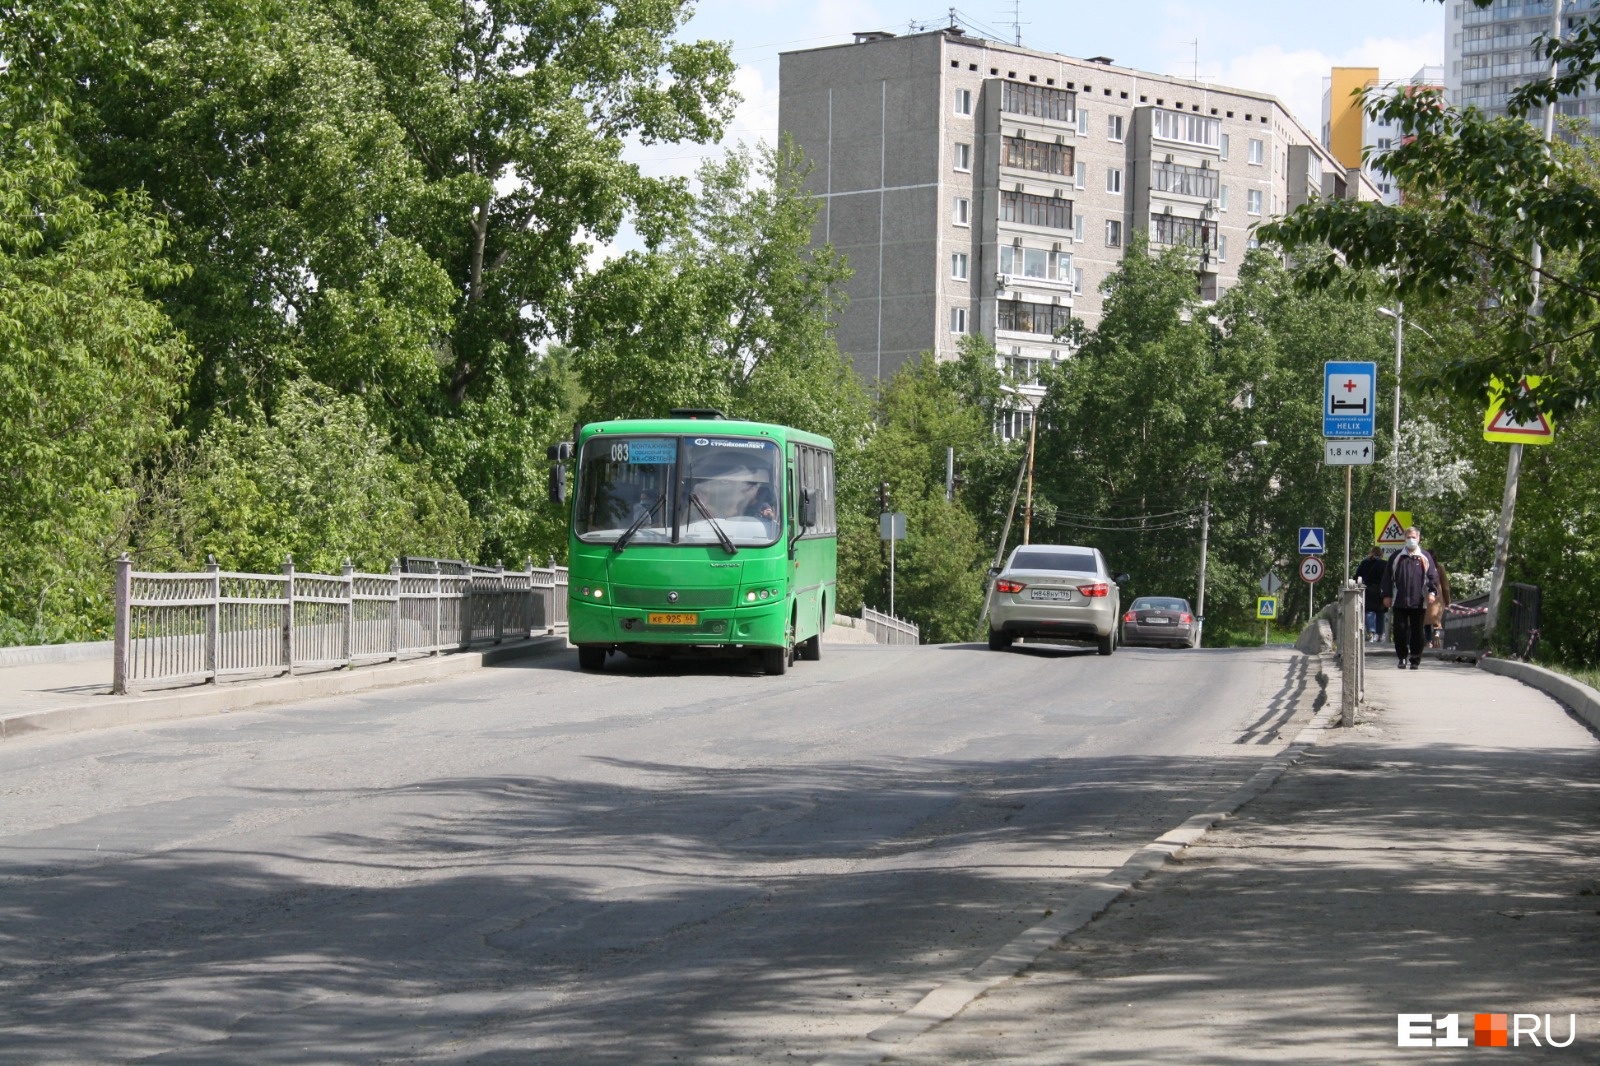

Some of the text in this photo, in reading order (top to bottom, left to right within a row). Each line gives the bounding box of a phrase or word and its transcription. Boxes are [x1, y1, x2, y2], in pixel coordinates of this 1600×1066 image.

[612, 444, 628, 461] 083
[1330, 448, 1342, 456] 1,8
[1305, 565, 1318, 574] 20
[666, 615, 681, 623] 925
